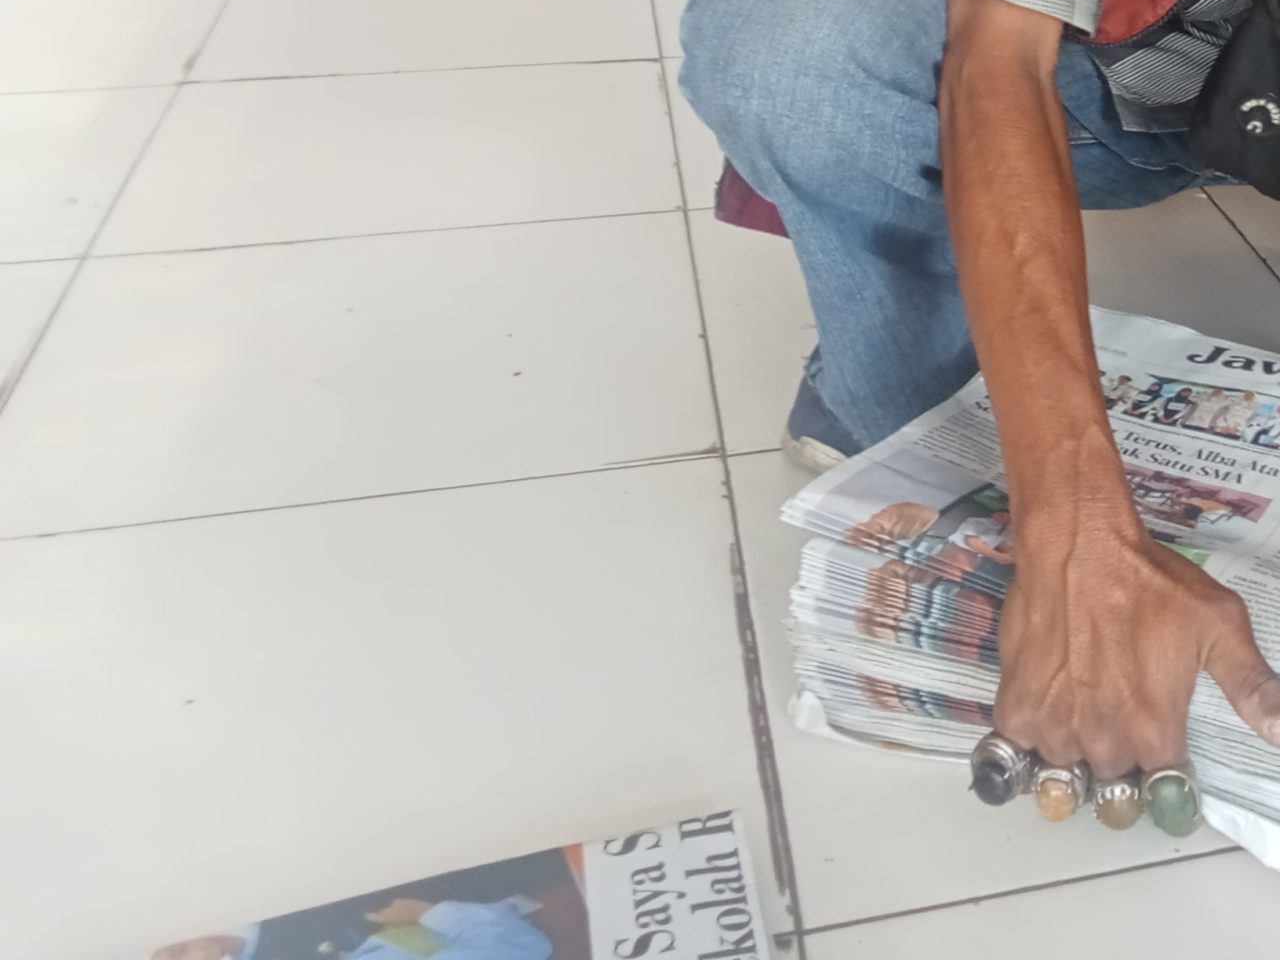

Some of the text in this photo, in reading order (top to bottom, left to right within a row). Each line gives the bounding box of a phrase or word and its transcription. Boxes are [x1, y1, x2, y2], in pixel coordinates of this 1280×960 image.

[1145, 451, 1194, 472] Satu
[1196, 465, 1243, 484] SMA
[613, 862, 686, 959] Saya
[685, 848, 760, 960] kolah
